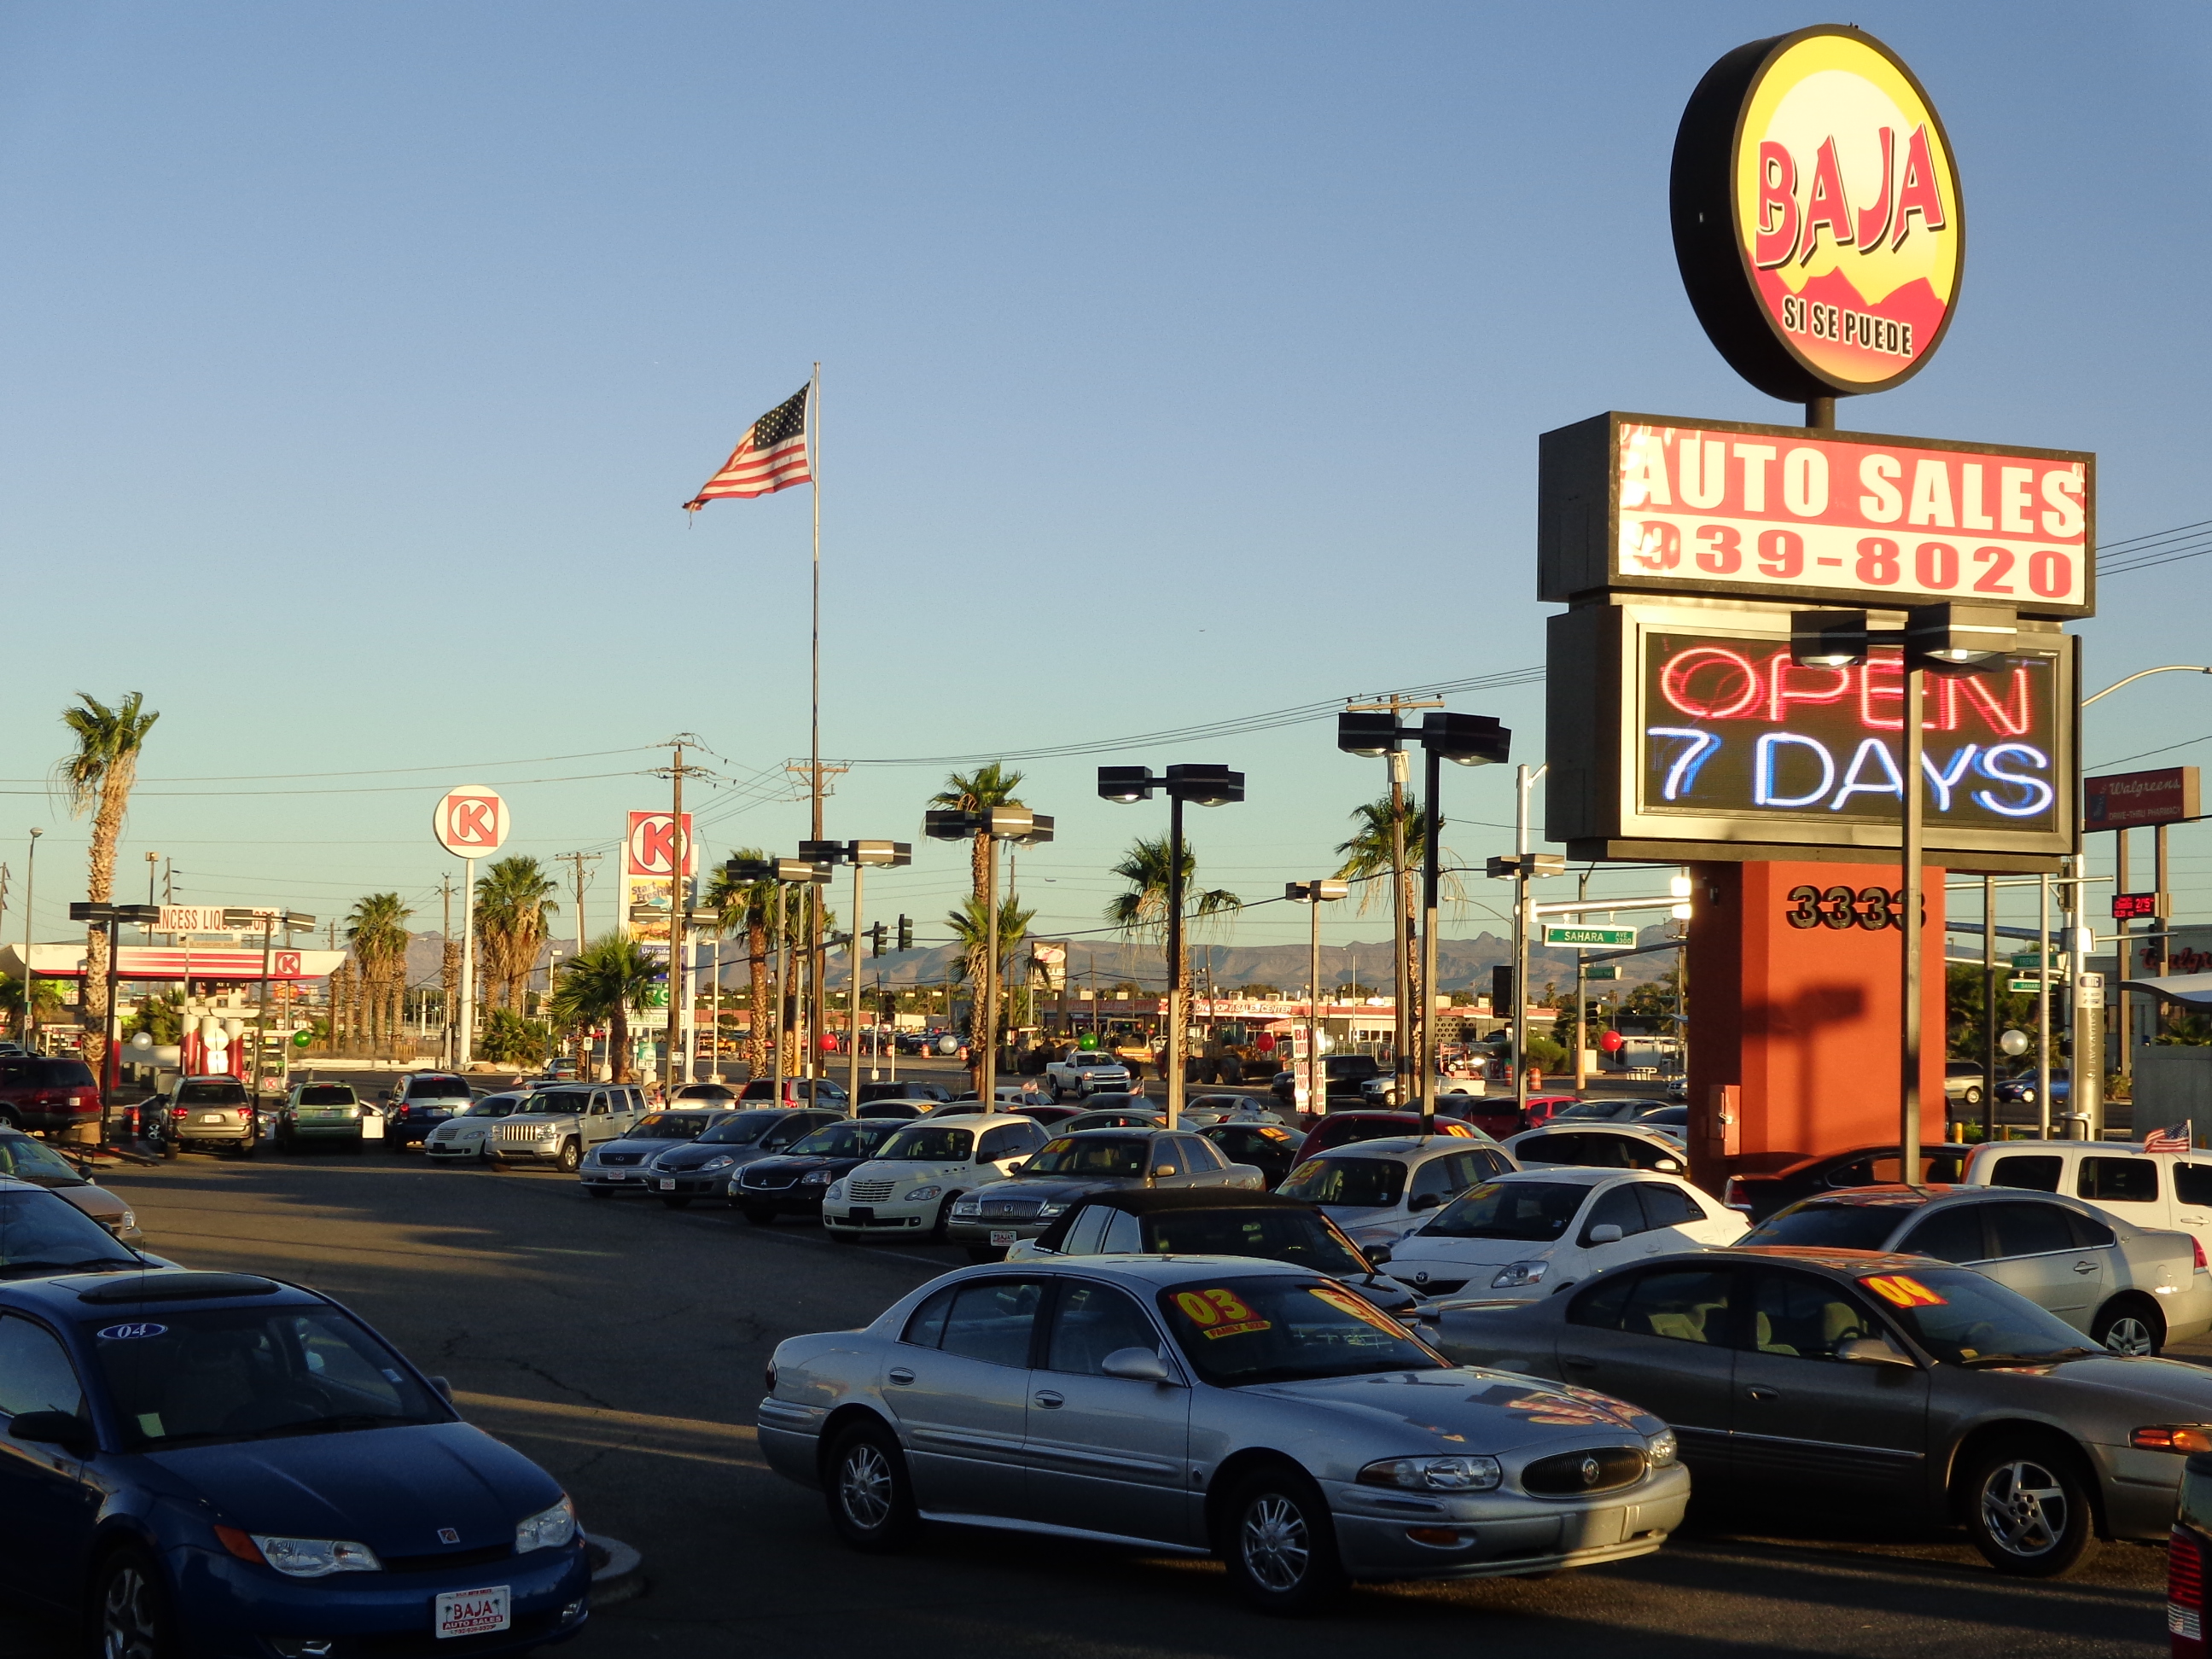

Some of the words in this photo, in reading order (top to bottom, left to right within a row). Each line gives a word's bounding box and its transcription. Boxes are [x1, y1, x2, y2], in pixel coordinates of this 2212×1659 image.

[1756, 121, 1947, 271] BAJA
[1783, 294, 1807, 334] SI
[1812, 301, 1839, 341] SE
[1843, 309, 1913, 359] PUEDE
[1621, 434, 1829, 518] AUTO
[1859, 452, 2084, 538] SALES
[1633, 520, 2072, 598] 939-8020
[1660, 646, 2029, 735] OPEN
[1647, 726, 1720, 800] 7
[1754, 730, 2052, 818] DAYS
[2109, 778, 2181, 798] Walgreens
[632, 882, 656, 894] Start
[143, 909, 198, 930] INCESS
[1564, 931, 1604, 942] SAHARA
[628, 1014, 651, 1023] VIDEO
[1235, 1004, 1260, 1013] SALES
[1260, 1005, 1292, 1014] CENTER
[1177, 1289, 1249, 1324] 03
[117, 1324, 147, 1338] 04
[1208, 1324, 1243, 1338] FAMILY
[453, 1600, 492, 1621] BAJA
[445, 1621, 470, 1630] AUTO
[472, 1615, 501, 1625] SALES
